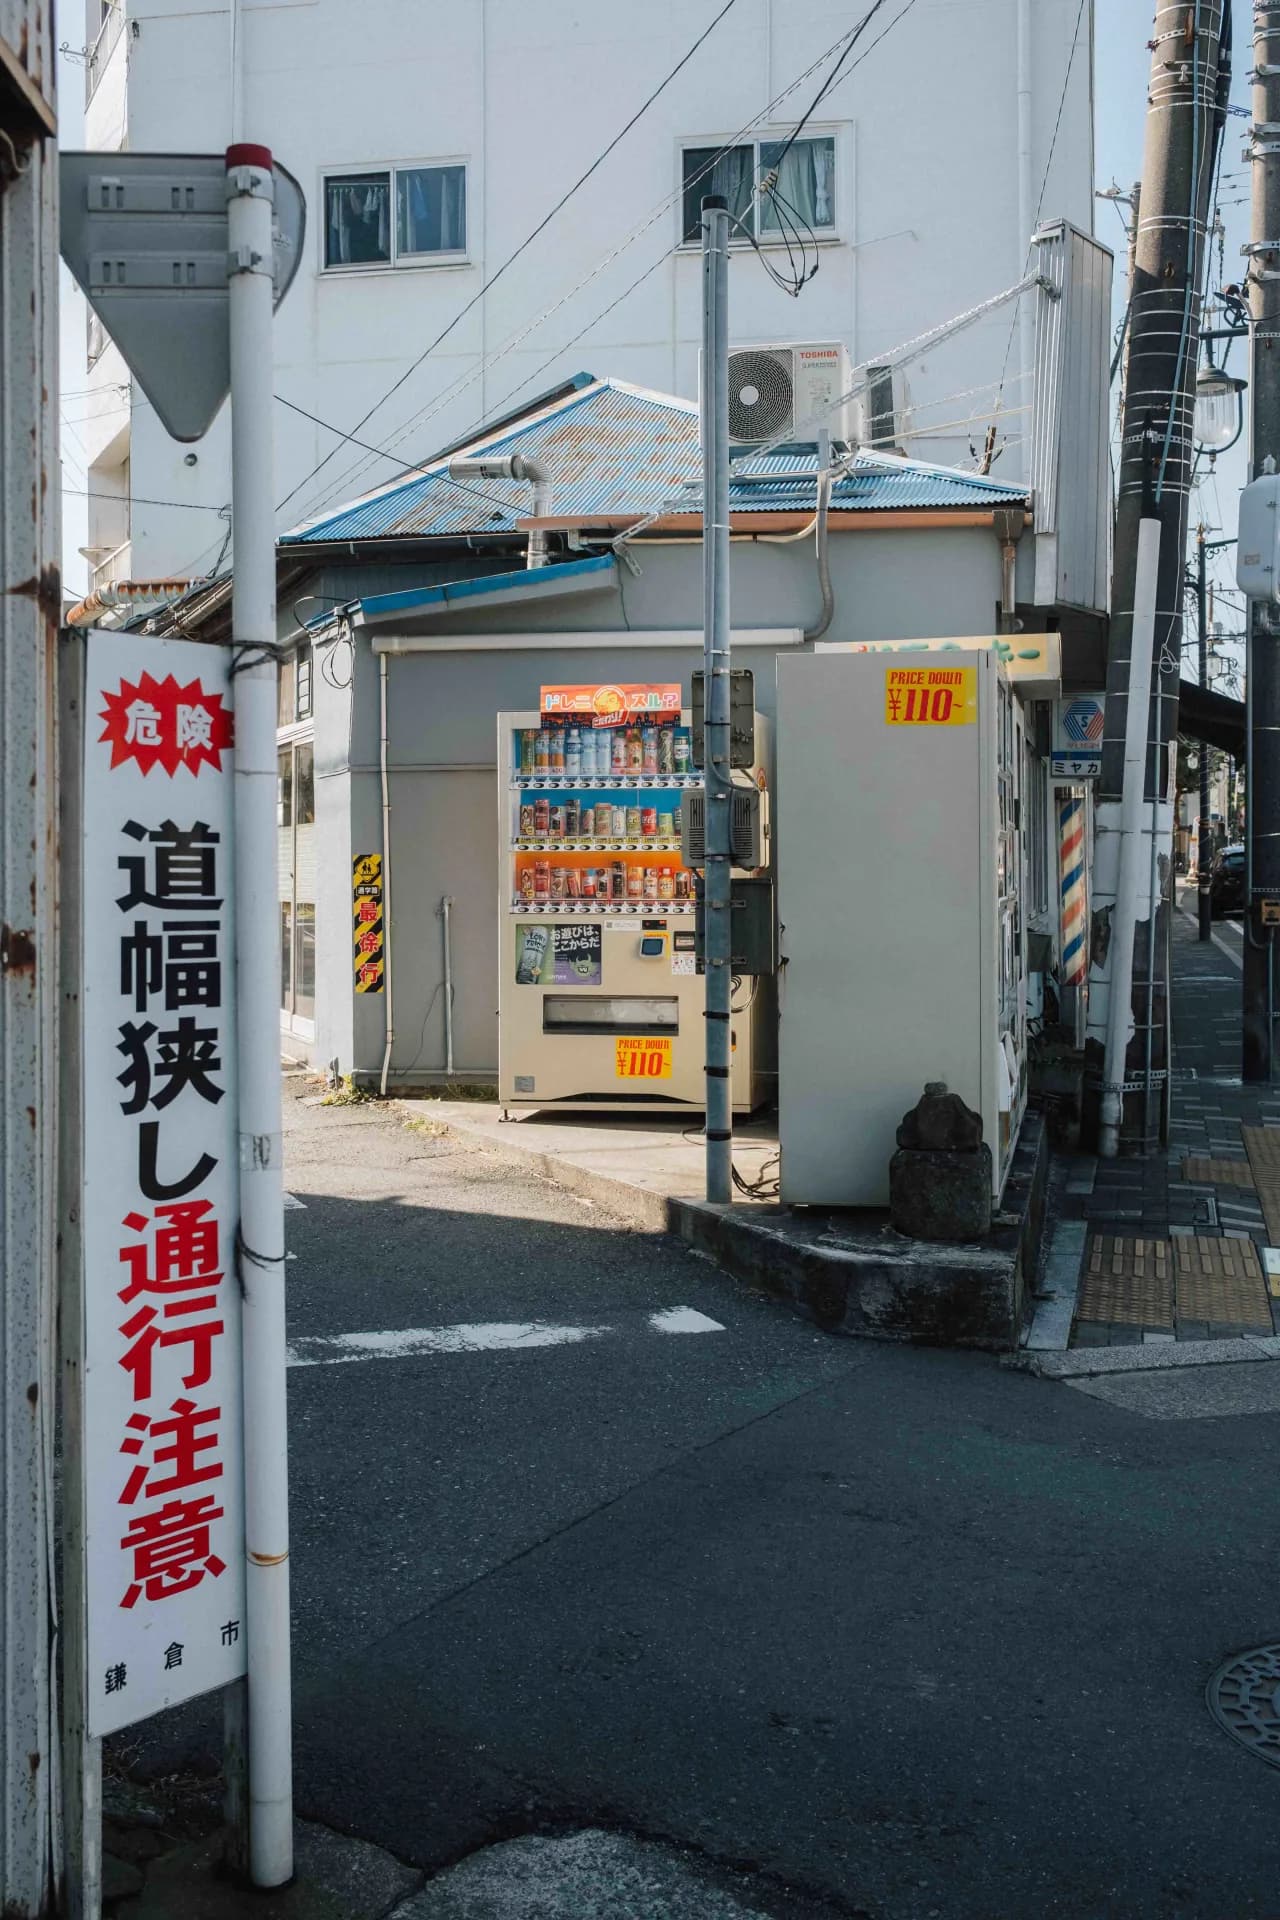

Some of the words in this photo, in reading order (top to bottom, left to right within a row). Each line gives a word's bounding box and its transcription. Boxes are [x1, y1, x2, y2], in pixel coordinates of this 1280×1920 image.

[800, 350, 838, 359] TOSHIBA
[890, 671, 925, 685] PRICE
[928, 671, 963, 685] DOWN
[124, 699, 215, 751] 危険
[359, 902, 379, 984] 最徐行
[552, 936, 601, 953] ここからだ
[617, 1039, 643, 1050] PRICE
[115, 818, 227, 1610] 道幅狭し通行注意
[105, 1620, 240, 1697] 鎌倉市
